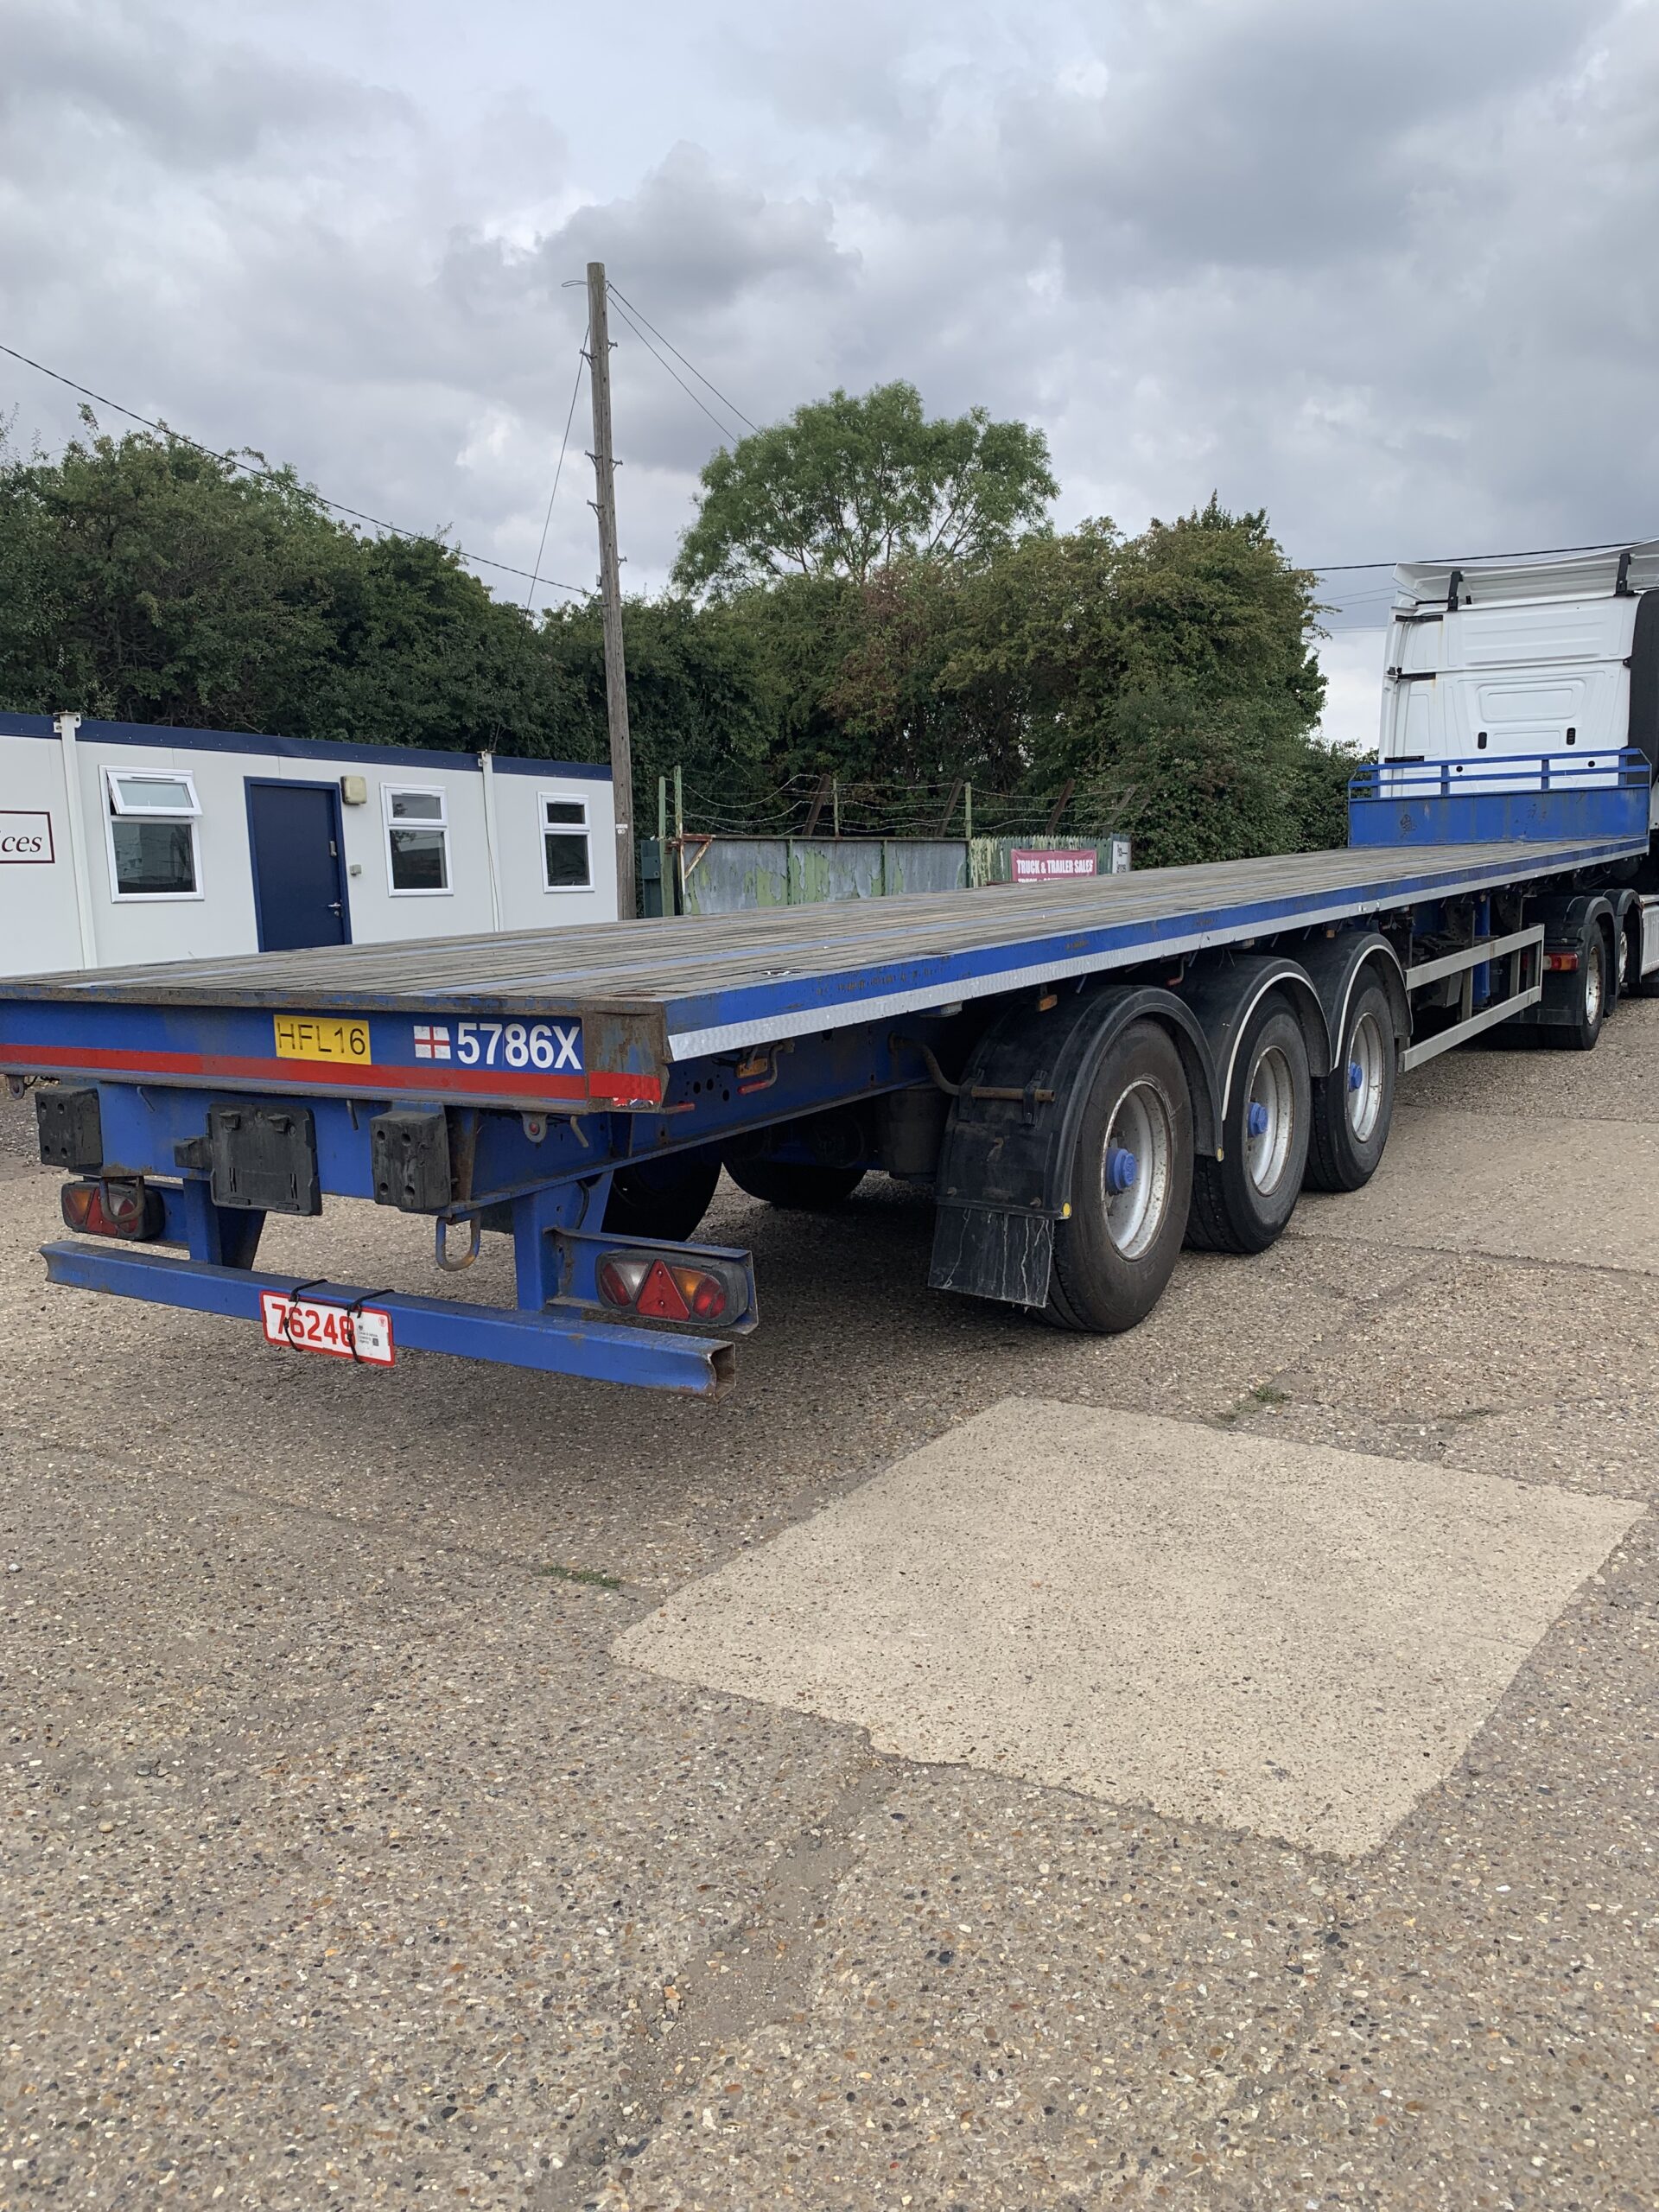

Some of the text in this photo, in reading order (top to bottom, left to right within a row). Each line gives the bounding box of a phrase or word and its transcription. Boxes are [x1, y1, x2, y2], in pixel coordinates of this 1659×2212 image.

[0, 836, 42, 853] ces
[1016, 859, 1093, 874] TRUCK & TRAILER SALES
[276, 1022, 365, 1055] HFL16
[457, 1021, 582, 1071] 5786X
